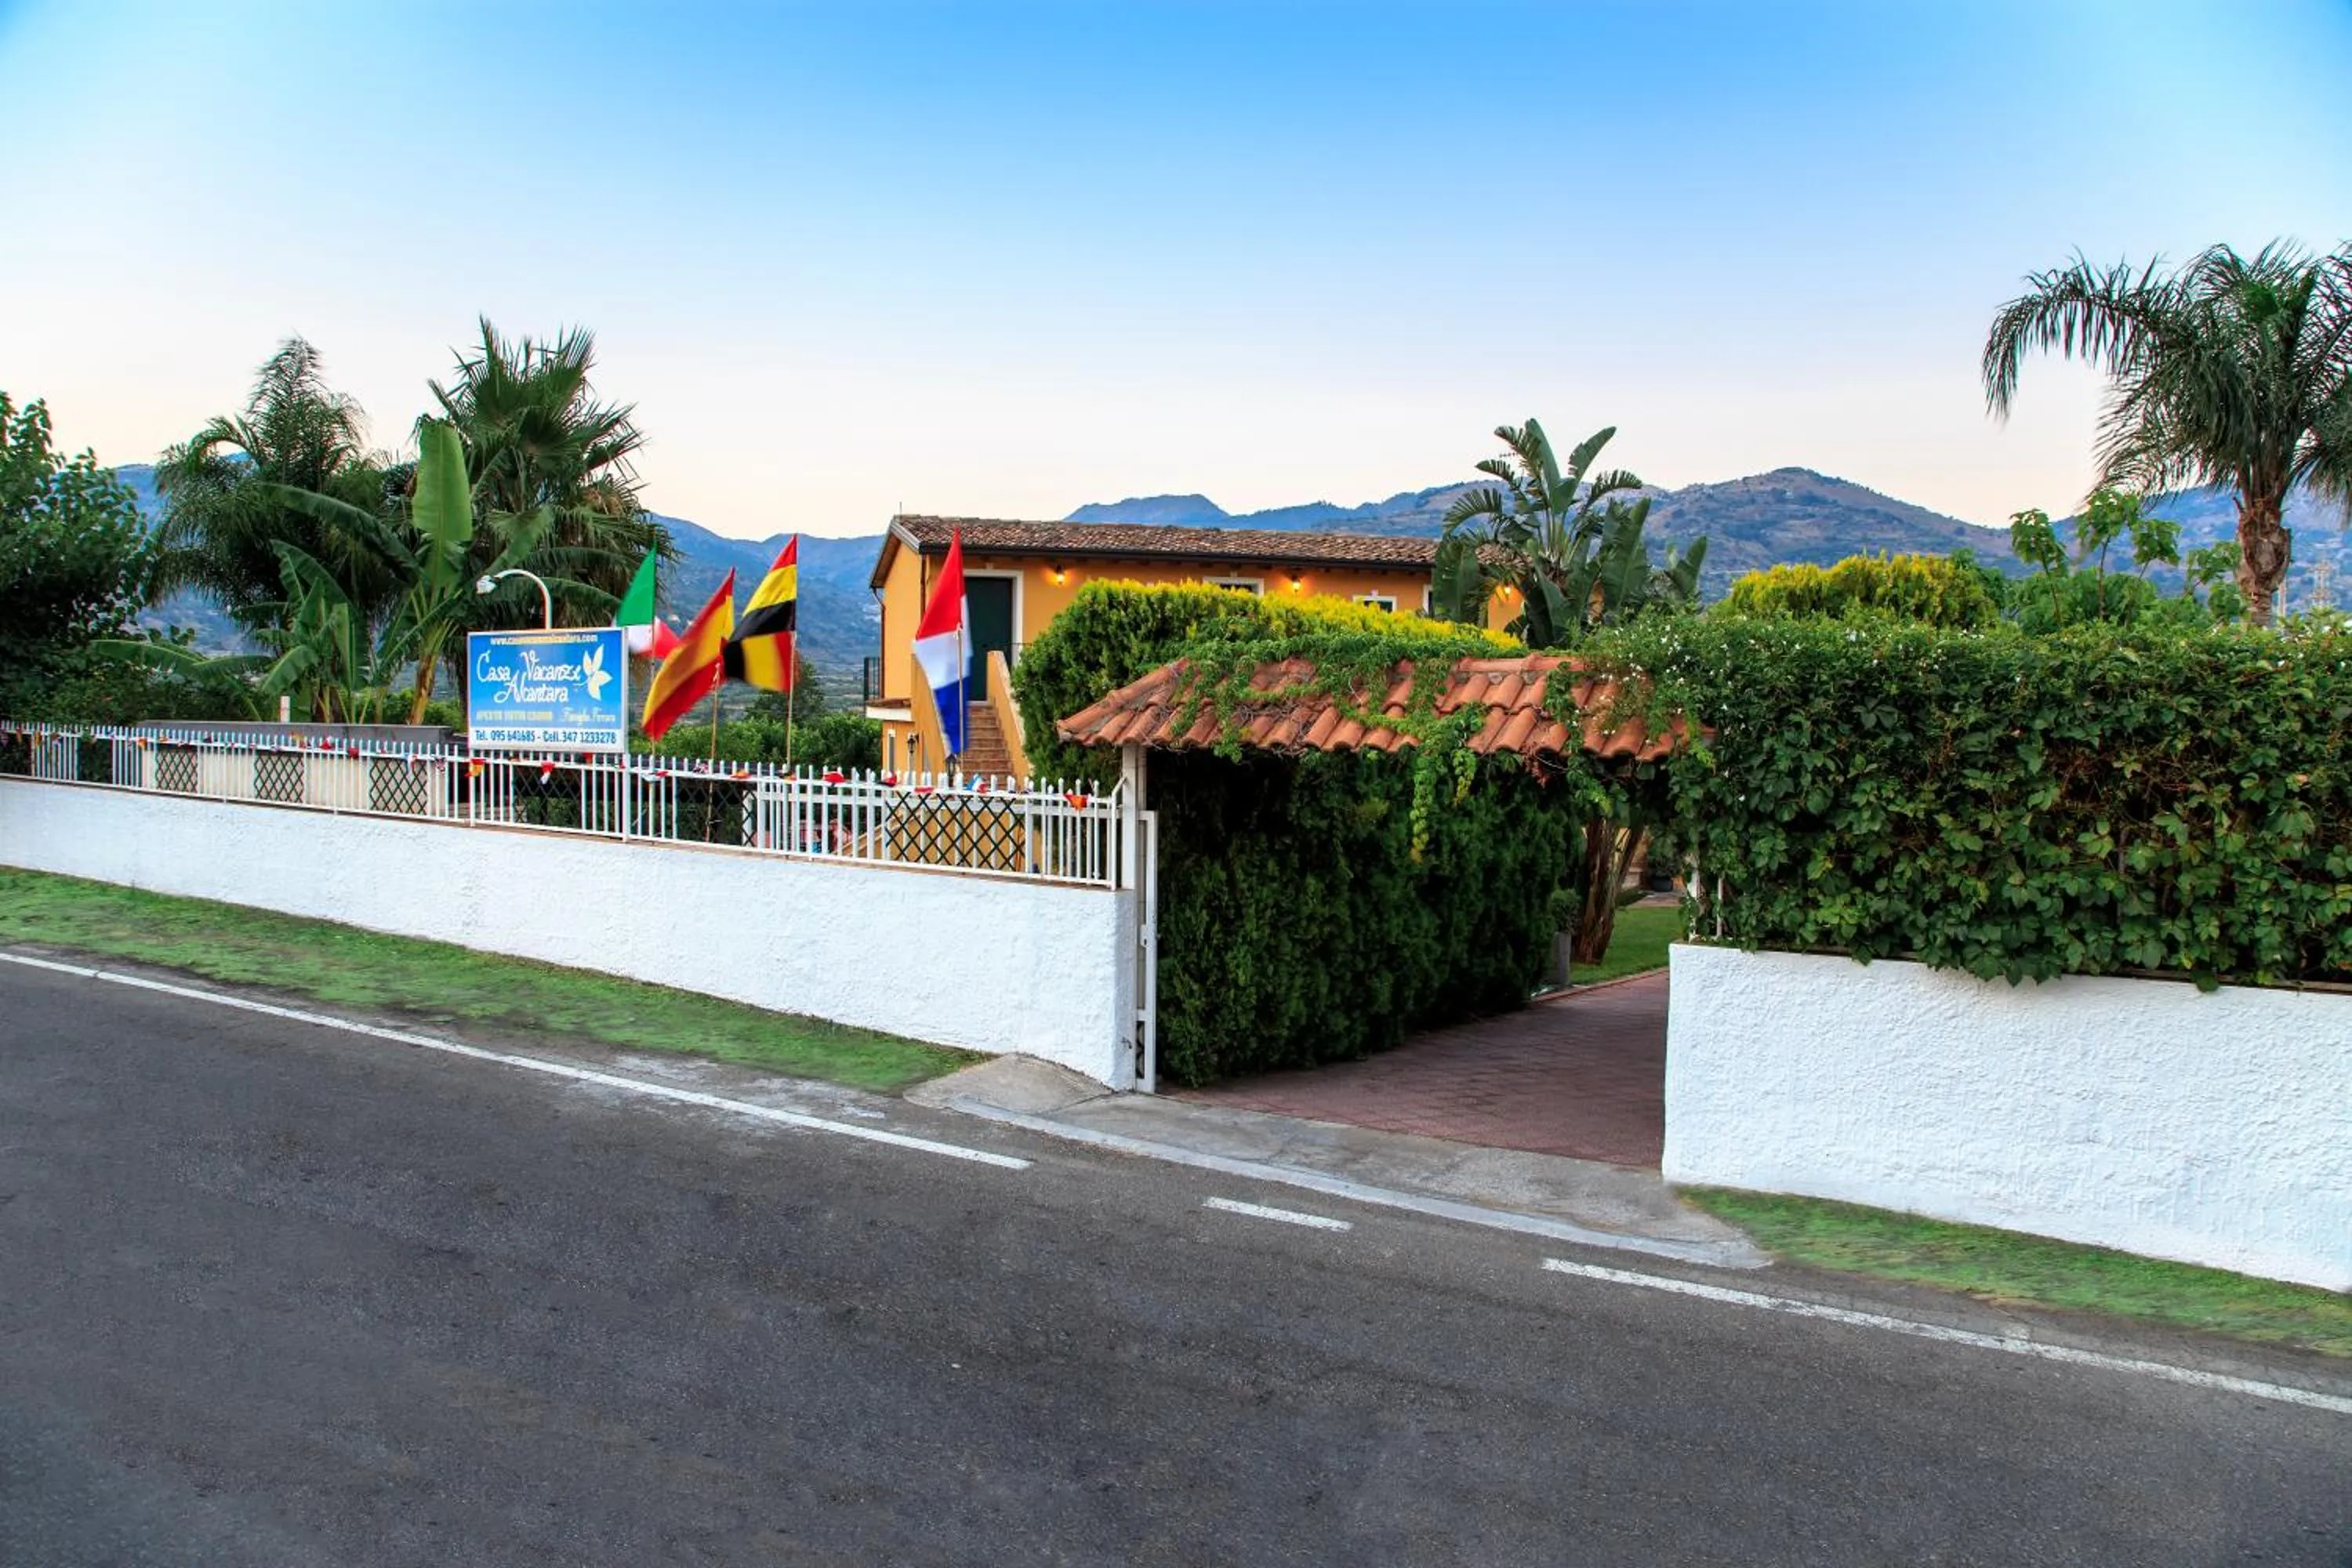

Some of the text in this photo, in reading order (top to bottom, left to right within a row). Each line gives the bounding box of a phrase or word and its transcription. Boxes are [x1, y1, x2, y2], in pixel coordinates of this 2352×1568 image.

[477, 650, 511, 683] Casa
[493, 670, 569, 703] Alcantara
[490, 730, 506, 741] 095
[580, 731, 615, 744] 1233278
